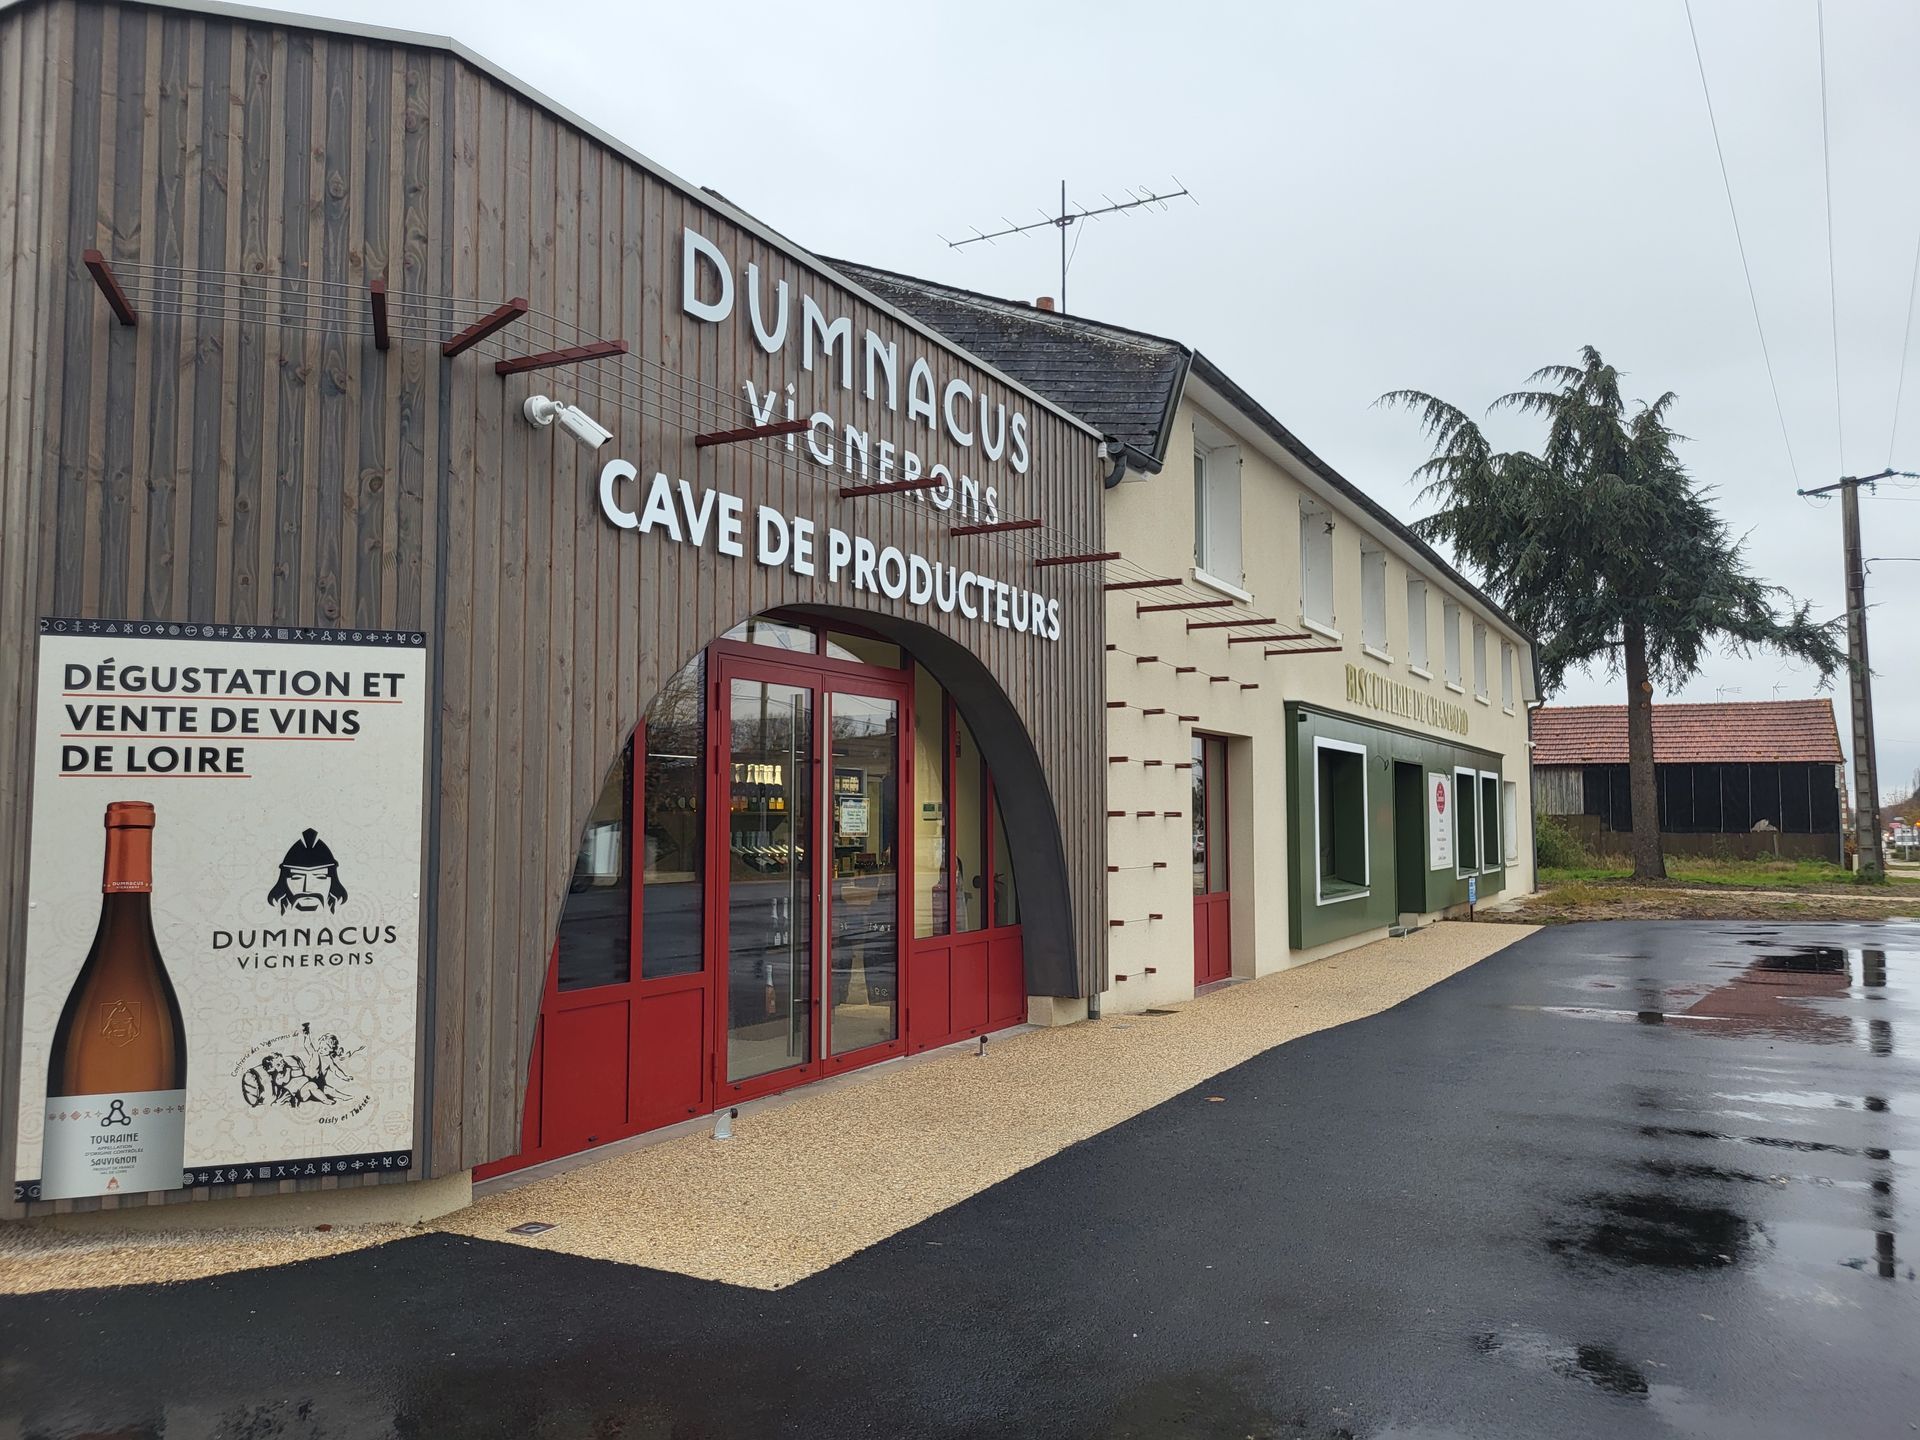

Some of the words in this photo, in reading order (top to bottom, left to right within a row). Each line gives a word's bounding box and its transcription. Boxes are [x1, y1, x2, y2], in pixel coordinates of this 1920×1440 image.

[683, 227, 1029, 475] DUMNACUS
[599, 459, 744, 558] CAVE
[758, 505, 815, 577] DE
[829, 528, 1060, 641] PRODUCTEURS
[64, 657, 351, 697] DÉGUSTATION
[363, 672, 406, 698] ET
[65, 704, 199, 733] VENTE
[210, 707, 260, 734] DE
[269, 708, 361, 735] VINS
[61, 745, 114, 772] DE
[127, 746, 245, 773] LOIRE
[212, 925, 398, 950] DUMNACUS
[90, 1132, 139, 1144] TOURAINE
[90, 1156, 137, 1166] SAUVIGNON
